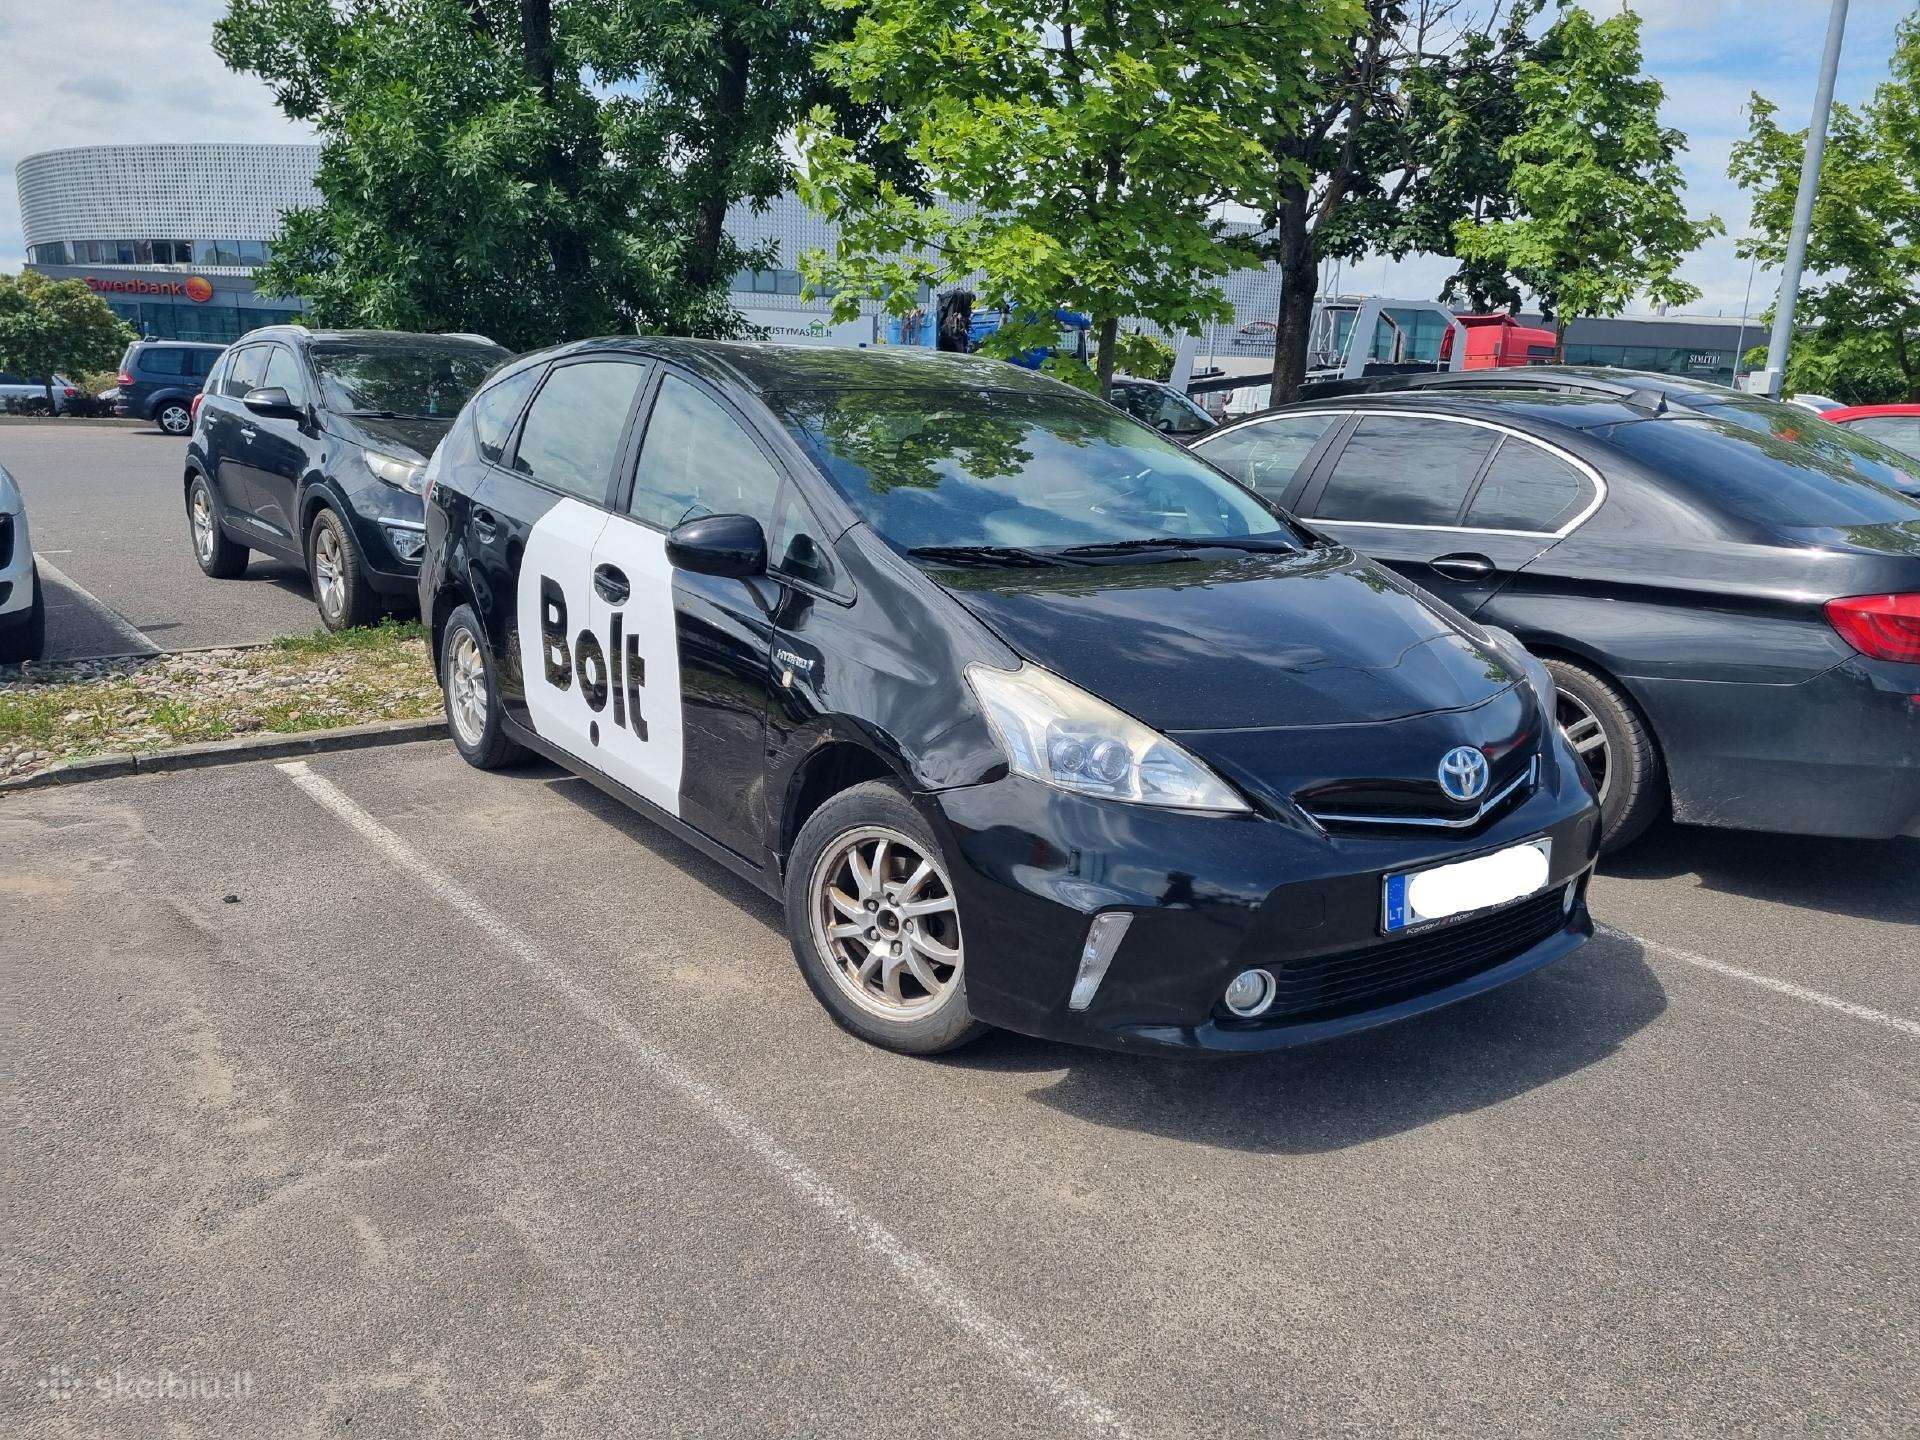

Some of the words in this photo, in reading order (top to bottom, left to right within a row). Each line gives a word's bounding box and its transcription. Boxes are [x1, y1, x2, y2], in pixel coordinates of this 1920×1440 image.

[84, 276, 182, 296] Swedbank
[540, 573, 649, 743] Bolt
[1389, 907, 1403, 921] LT
